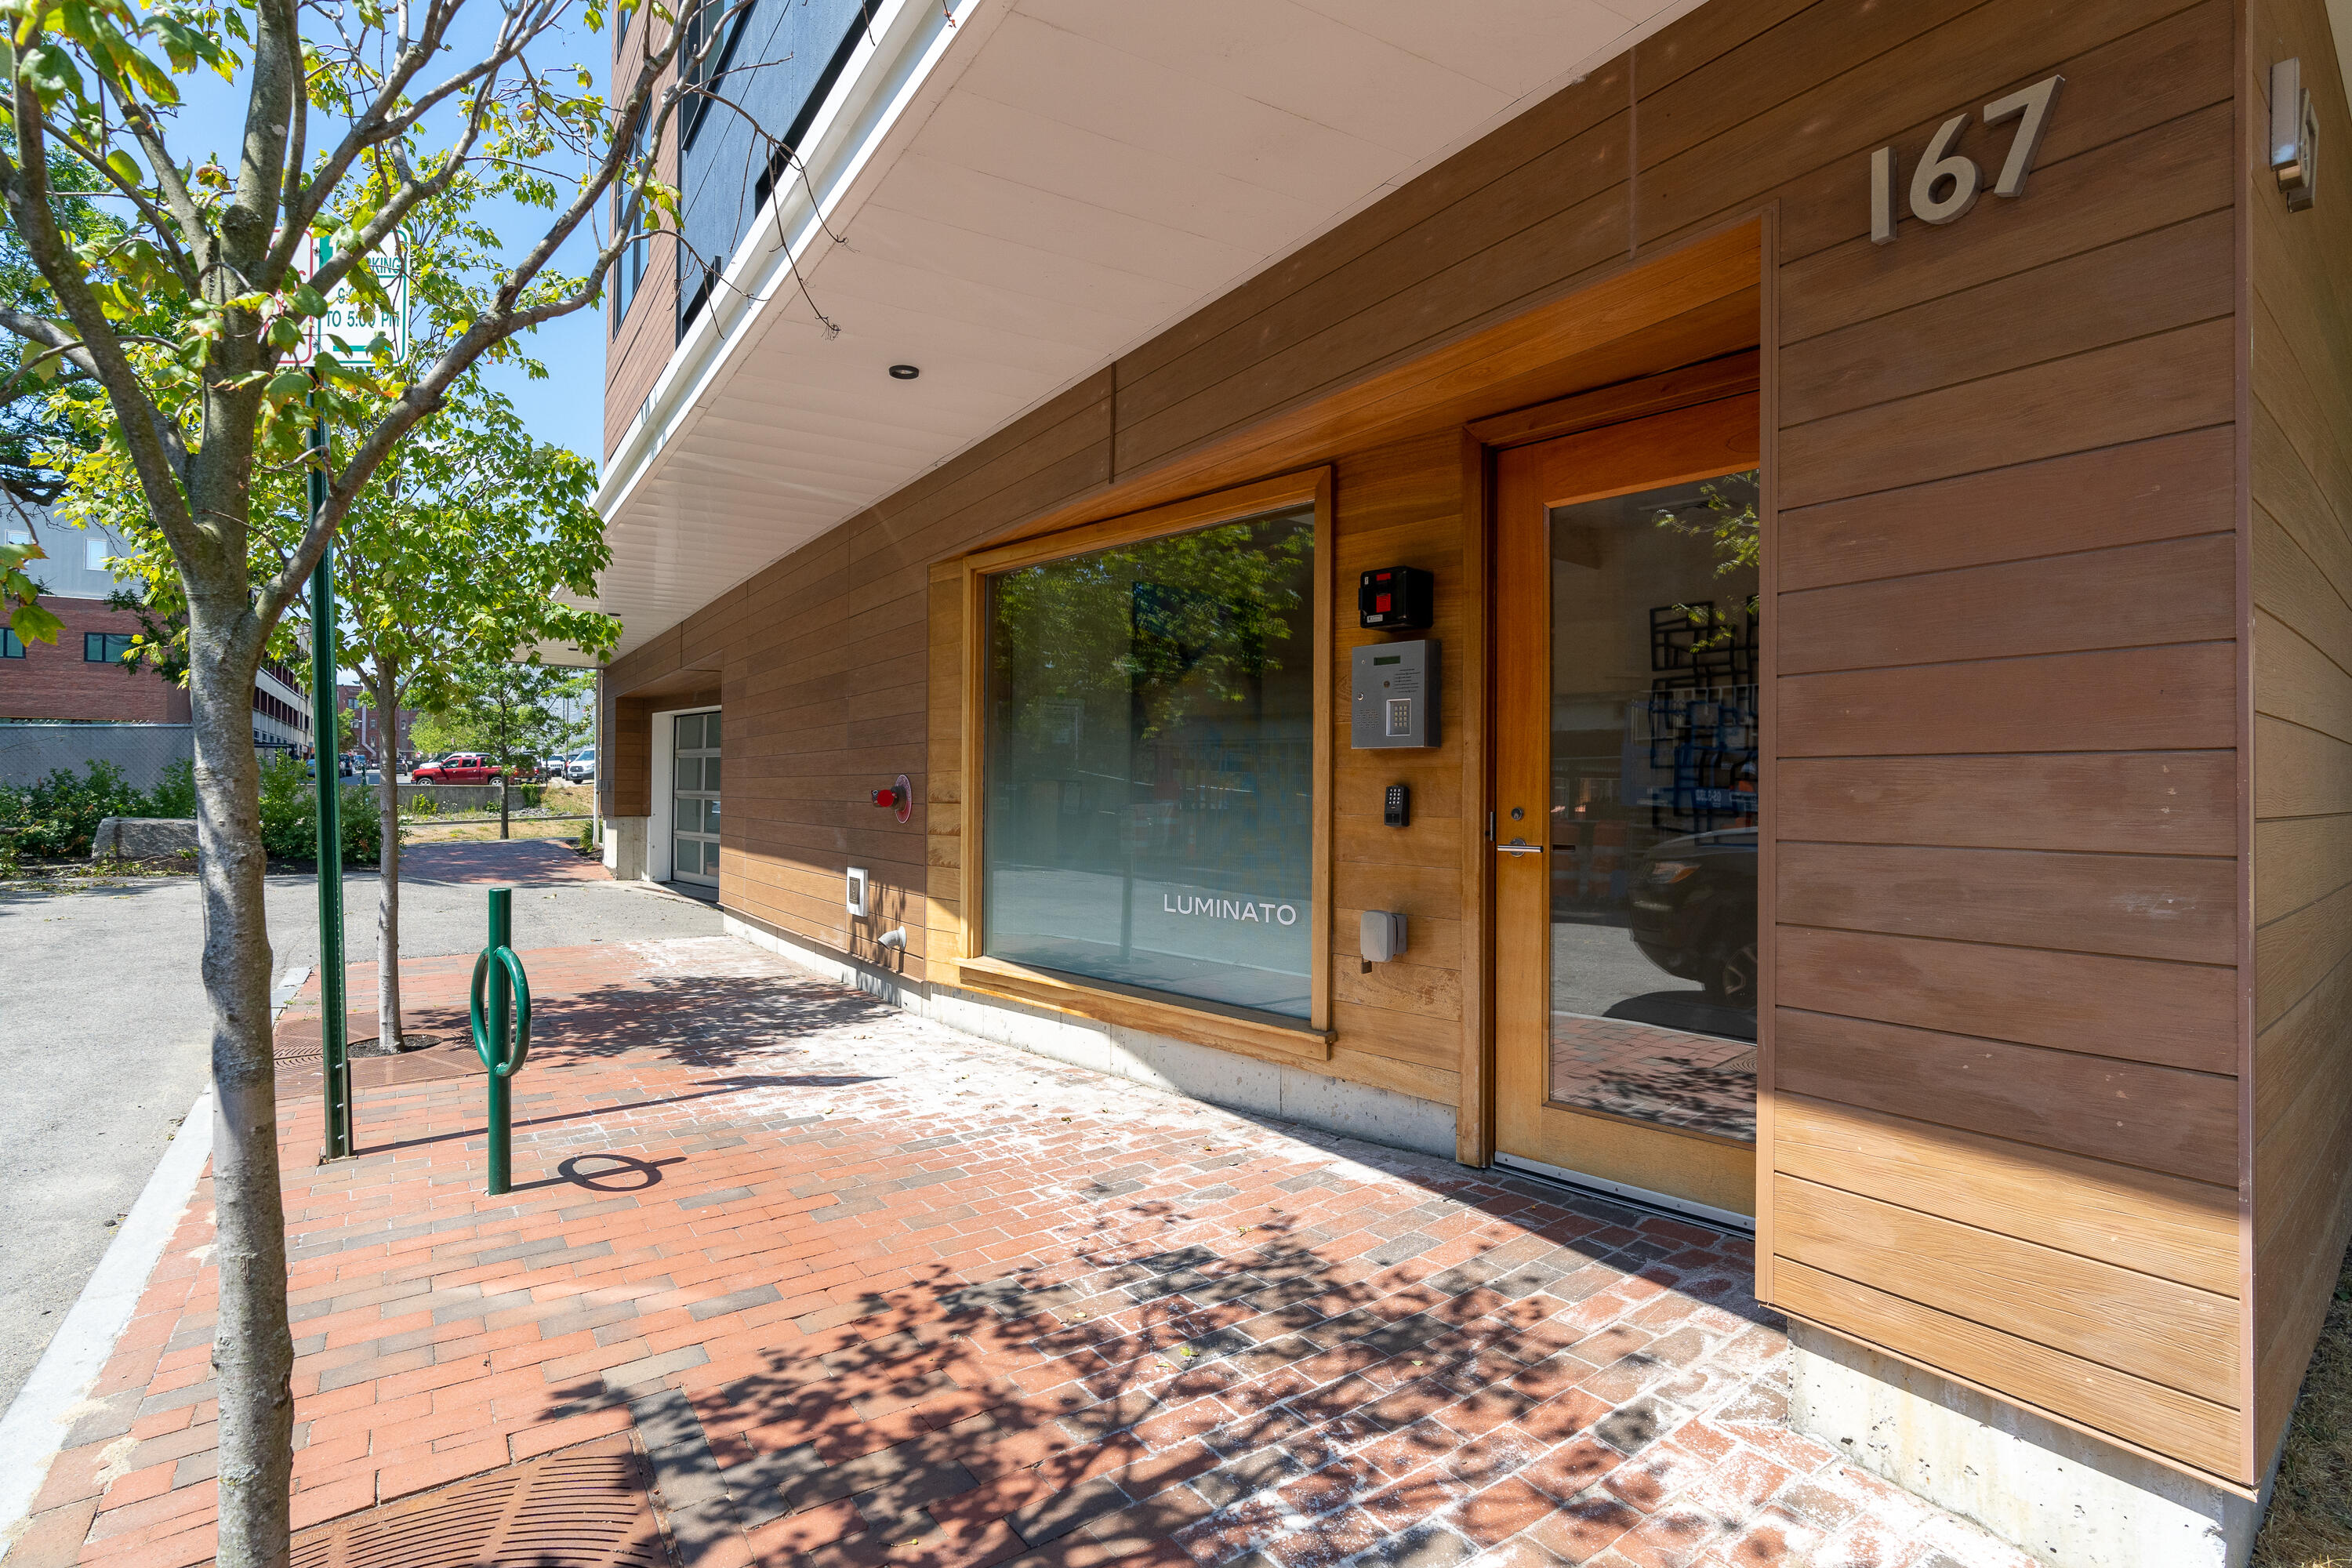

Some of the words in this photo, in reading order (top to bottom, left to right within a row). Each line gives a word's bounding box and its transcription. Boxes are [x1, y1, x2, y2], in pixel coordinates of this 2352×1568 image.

[1871, 74, 2065, 245] 167
[326, 310, 342, 327] TO
[381, 310, 400, 327] PM
[1163, 894, 1297, 926] LUMINATO
